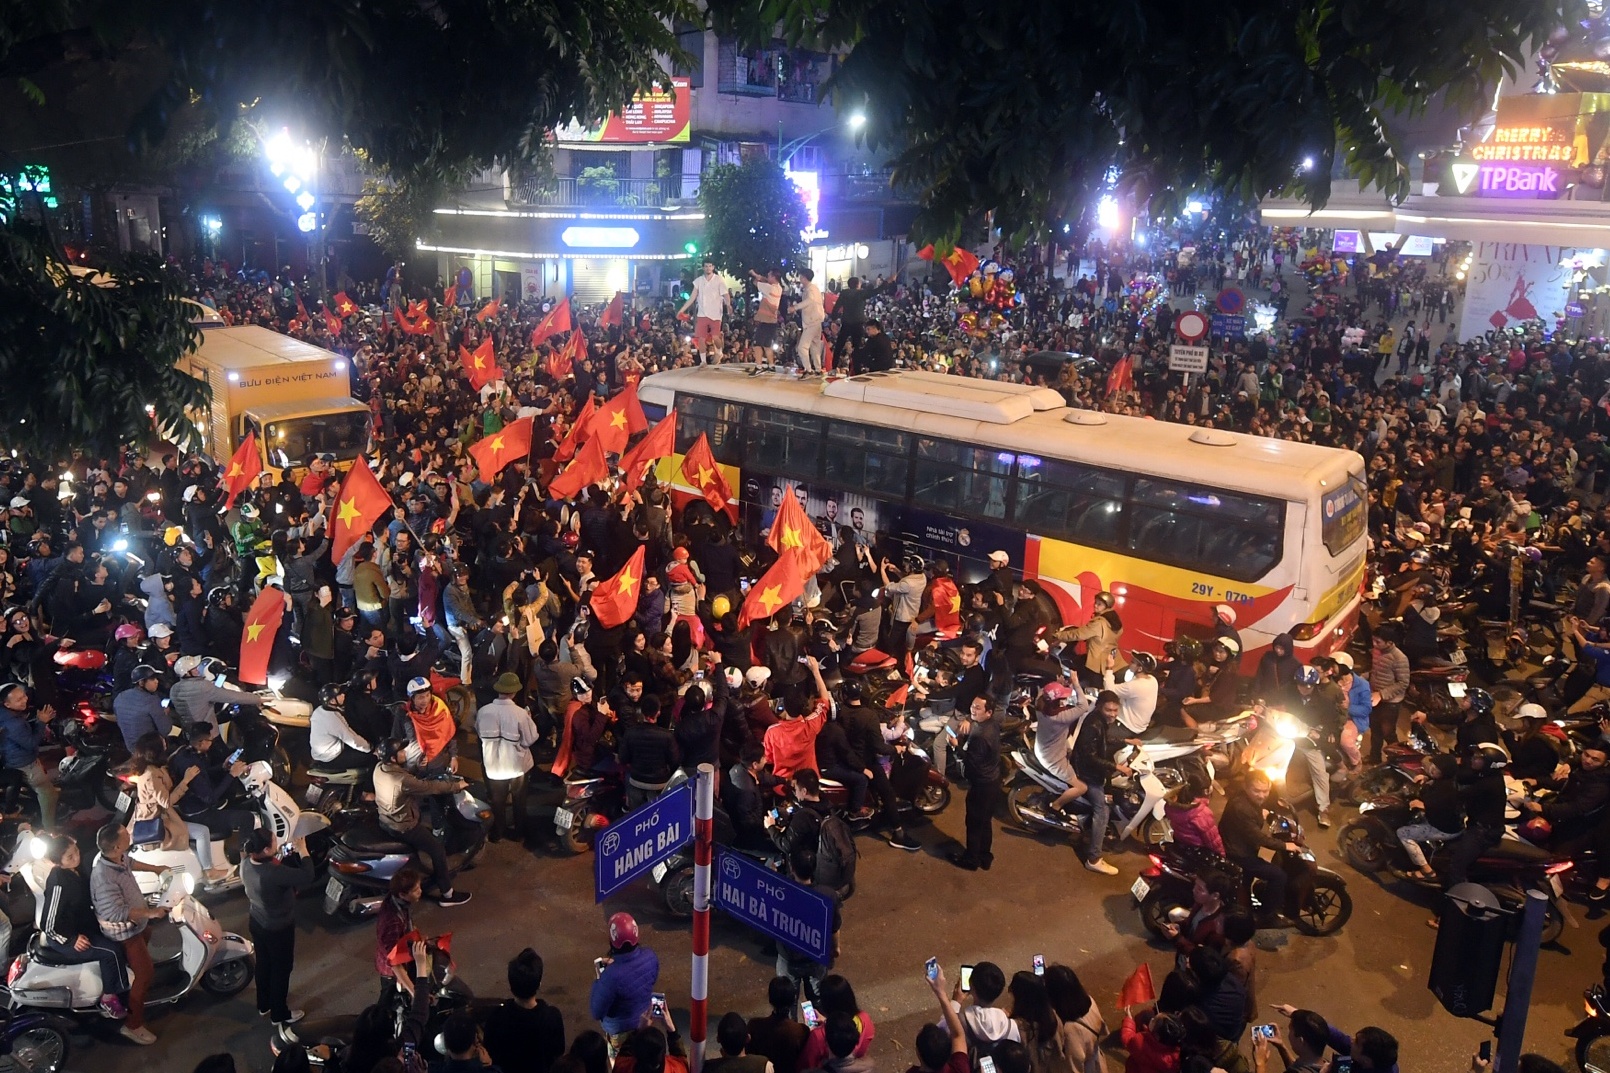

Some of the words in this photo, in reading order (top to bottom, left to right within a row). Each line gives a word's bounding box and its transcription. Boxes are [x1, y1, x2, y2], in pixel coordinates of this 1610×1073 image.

[1495, 127, 1552, 142] MERRY
[1472, 145, 1572, 160] CHRISTMAS
[1481, 167, 1558, 191] TPBank
[239, 379, 262, 388] BƯU
[265, 375, 290, 386] ĐIỆN
[291, 372, 313, 382] VIỆT
[315, 371, 337, 379] NAM
[1191, 582, 1214, 597] 29Y
[635, 807, 660, 836] PHỐ
[614, 839, 653, 879] HÀNG
[657, 822, 680, 852] BÀI
[756, 879, 786, 901] PHỐ
[722, 882, 745, 910] HAI
[749, 896, 768, 922] BÀ
[771, 907, 821, 949] TRƯNG
